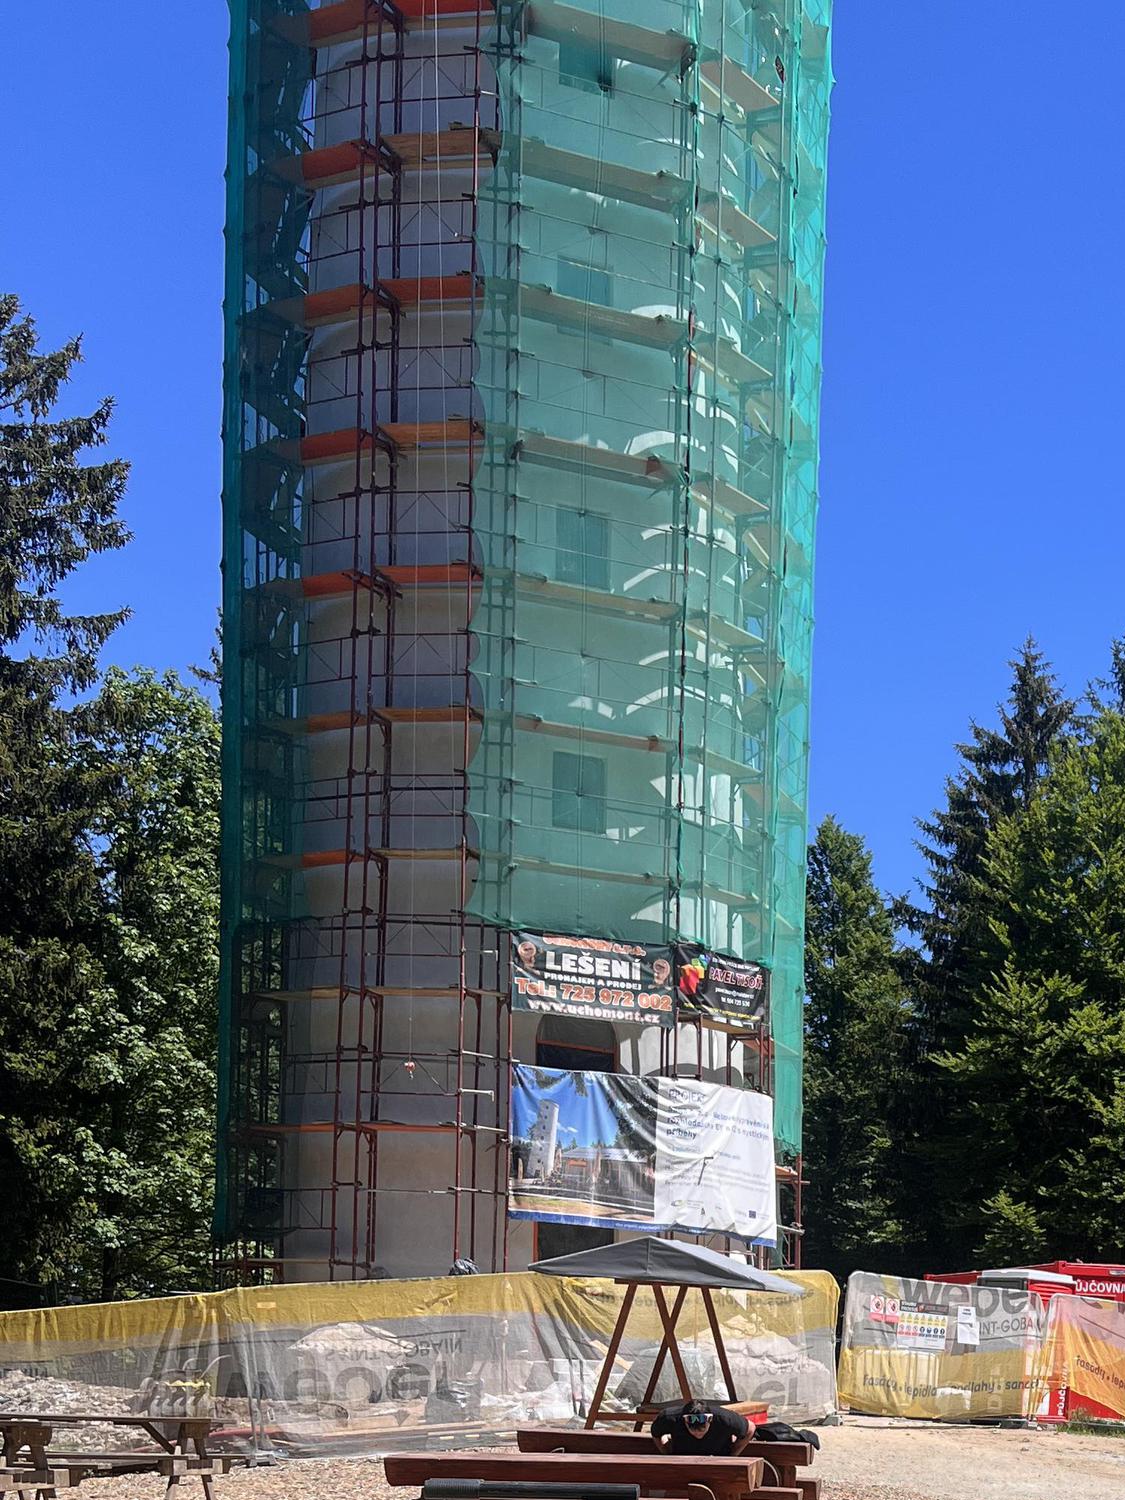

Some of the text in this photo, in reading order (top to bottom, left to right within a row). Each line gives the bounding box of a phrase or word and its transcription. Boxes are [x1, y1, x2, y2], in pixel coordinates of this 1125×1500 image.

[546, 951, 641, 980] LEŠENÍ
[709, 966, 736, 985] PAVEL
[560, 983, 596, 1002] 725
[599, 988, 634, 1007] 972
[607, 981, 642, 991] PRODEJ
[527, 999, 661, 1024] www.uchomont.cz
[904, 1380, 938, 1398] lepidla
